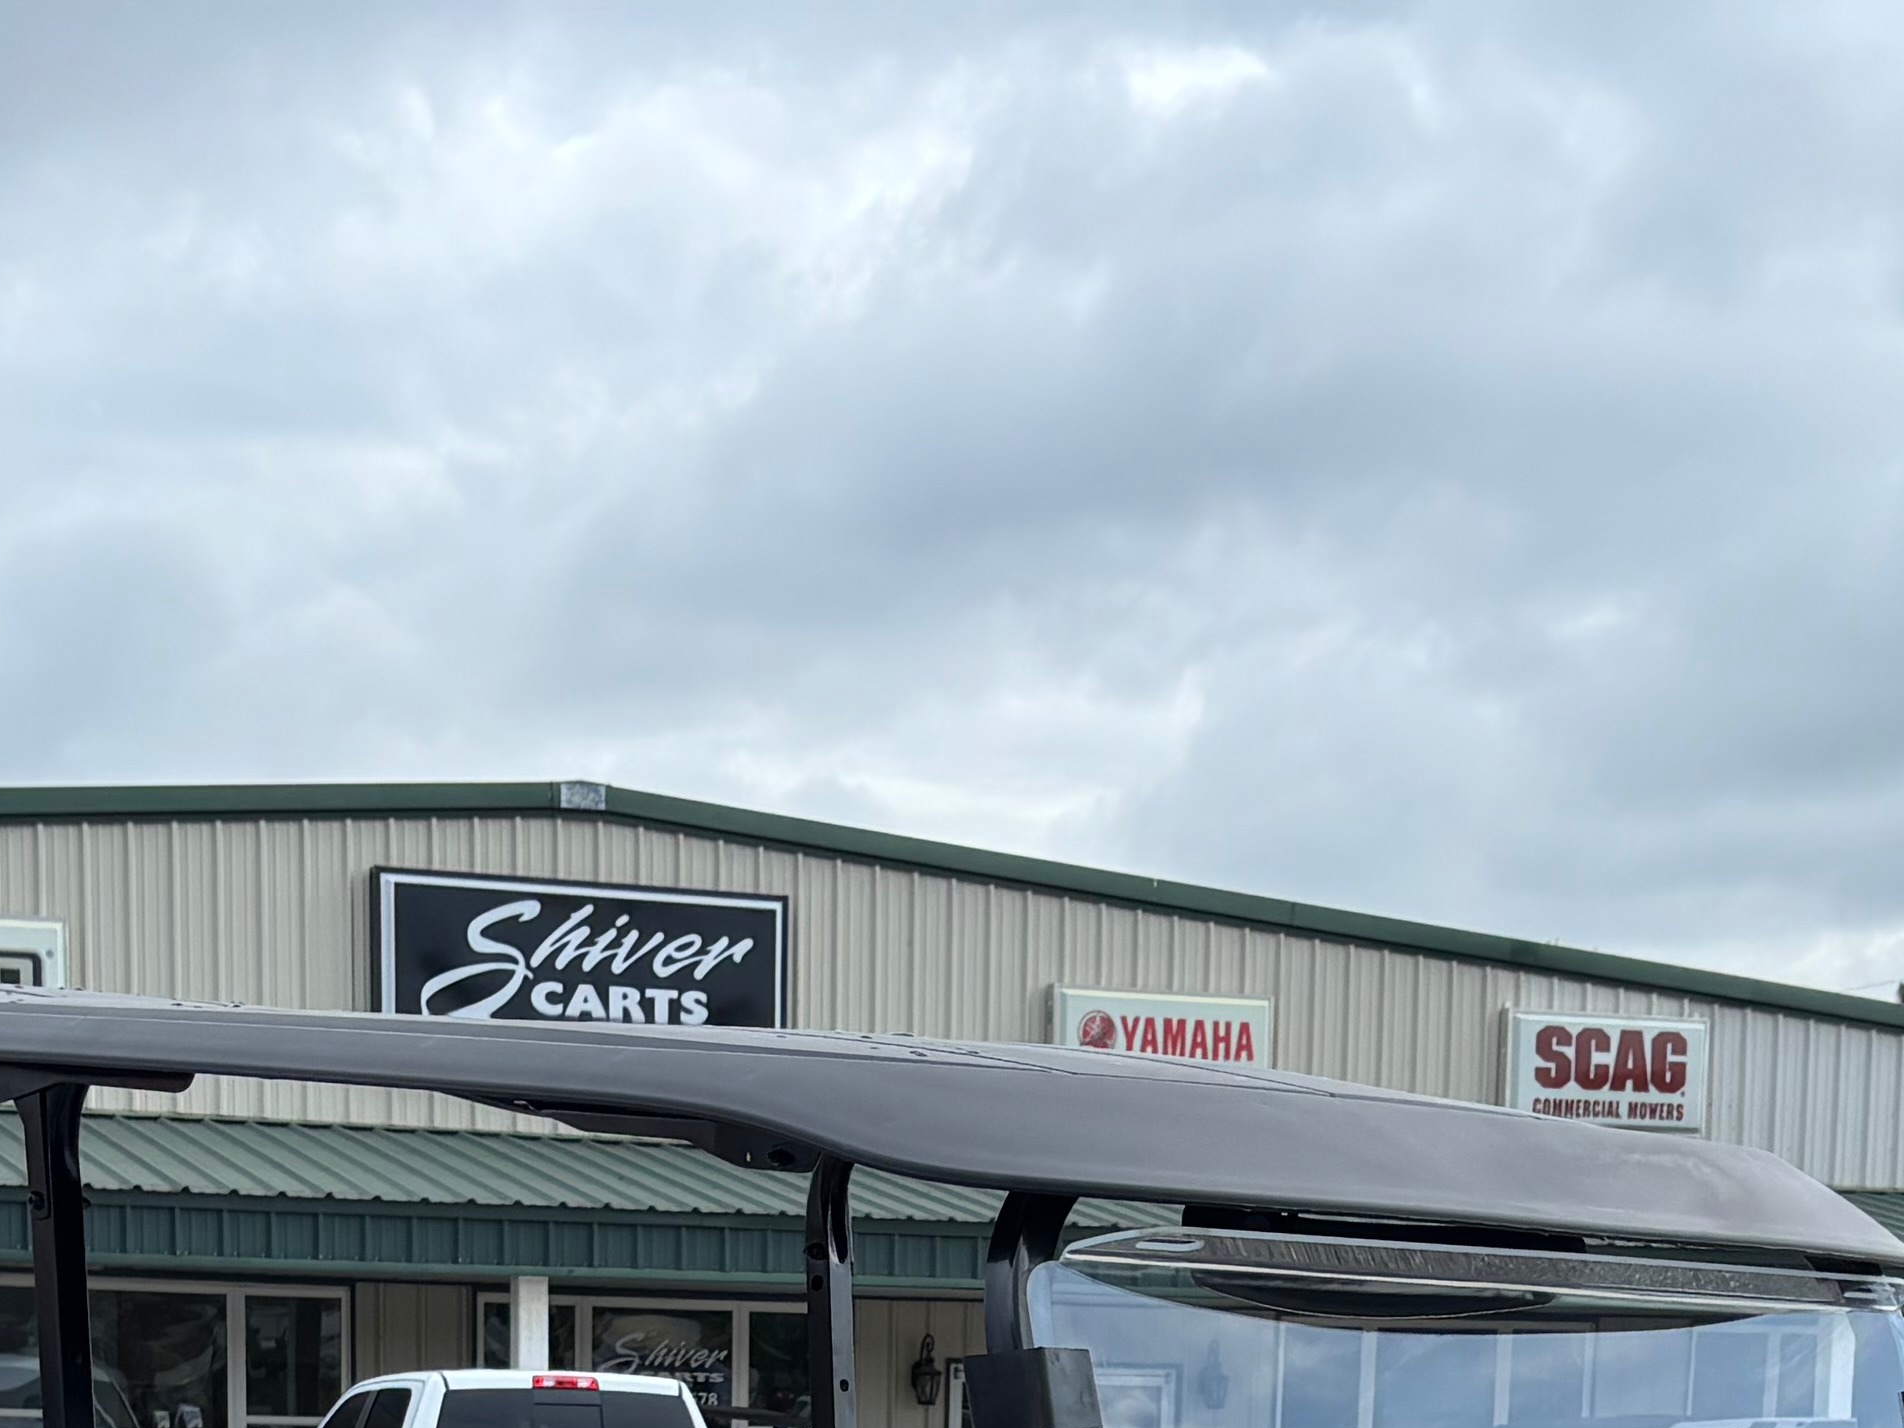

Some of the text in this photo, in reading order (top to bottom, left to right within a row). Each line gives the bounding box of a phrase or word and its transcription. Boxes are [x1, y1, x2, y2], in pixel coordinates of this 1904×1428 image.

[420, 899, 754, 1020] Shiver
[530, 981, 709, 1026] CARTS
[1120, 1015, 1255, 1062] YAMAHA
[1534, 1025, 1689, 1095] SCAG
[1532, 1097, 1684, 1121] COMMERCIAL MOWERS
[598, 1332, 729, 1374] Shiver
